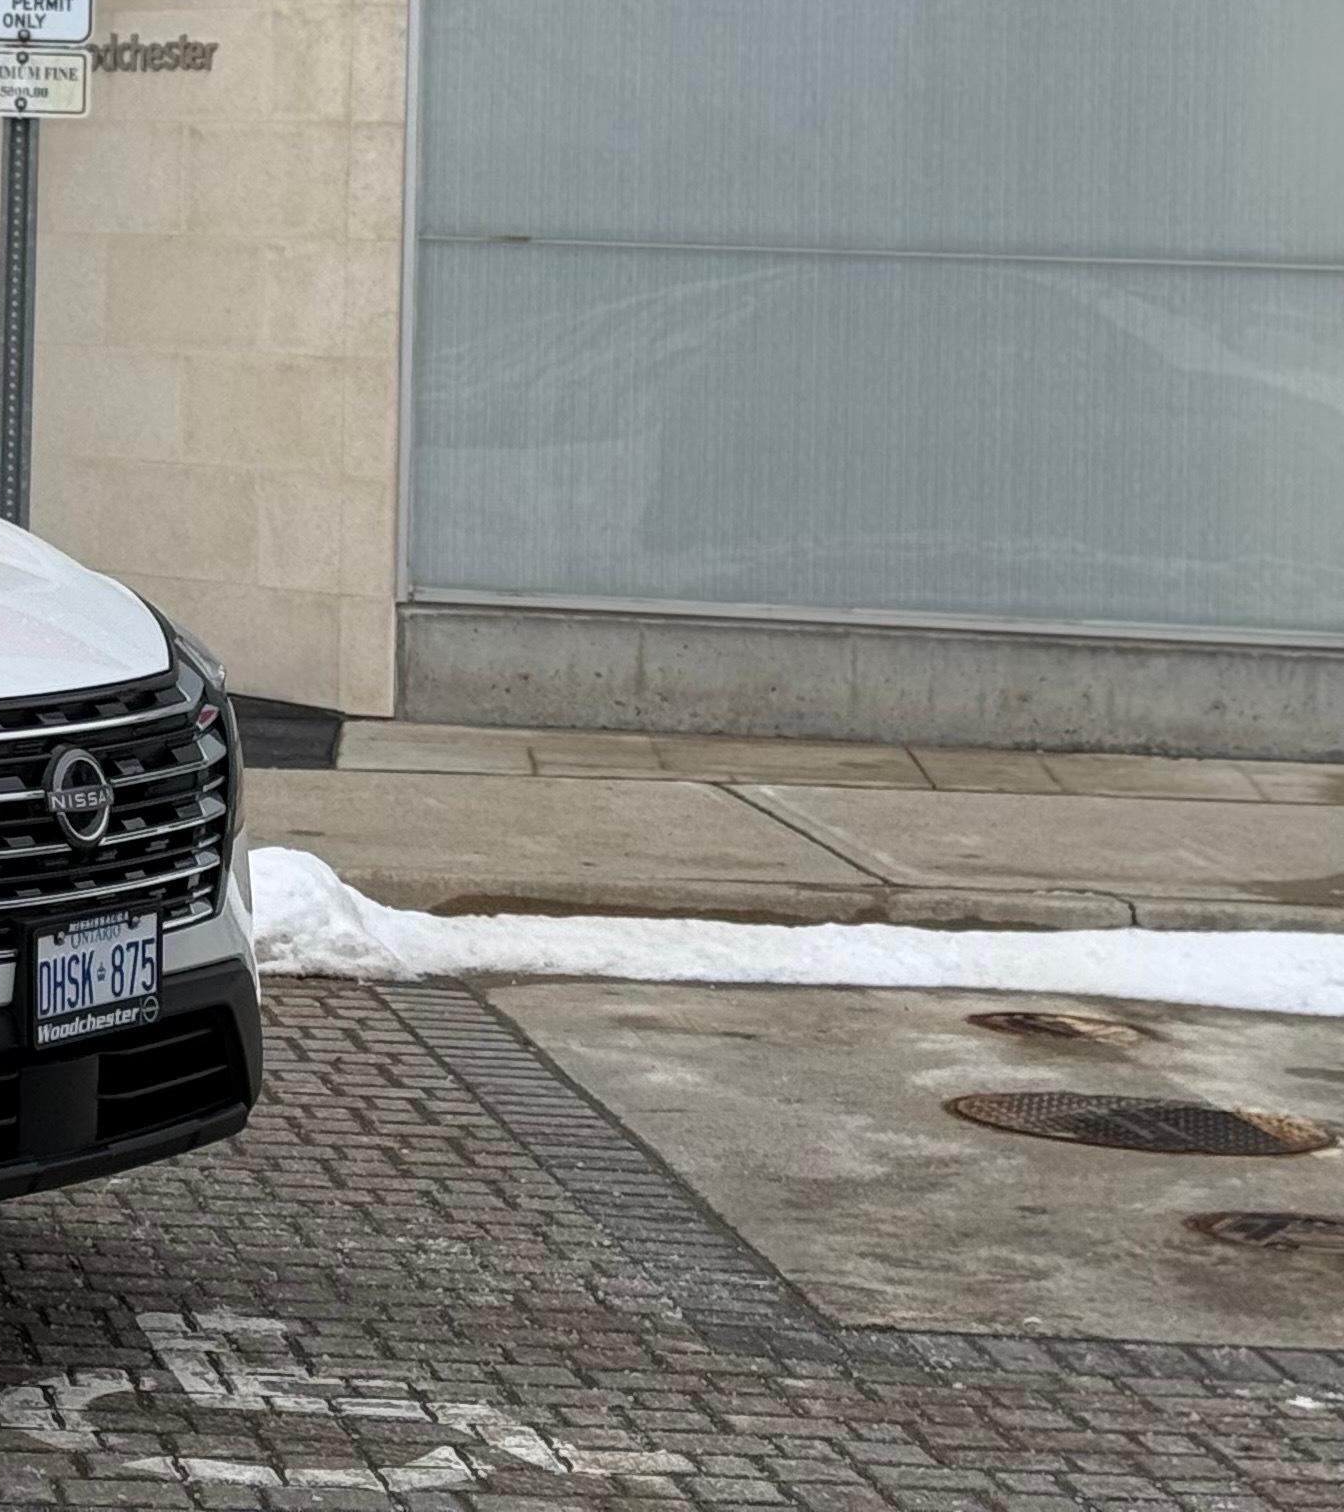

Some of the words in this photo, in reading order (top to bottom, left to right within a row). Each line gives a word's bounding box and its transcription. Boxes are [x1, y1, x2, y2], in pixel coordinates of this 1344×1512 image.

[2, 12, 47, 29] ONLY
[86, 32, 219, 72] odchester
[45, 66, 79, 82] FINE
[39, 949, 95, 1016] DHSK
[111, 937, 156, 998] 875
[37, 1006, 140, 1045] Woodchester
